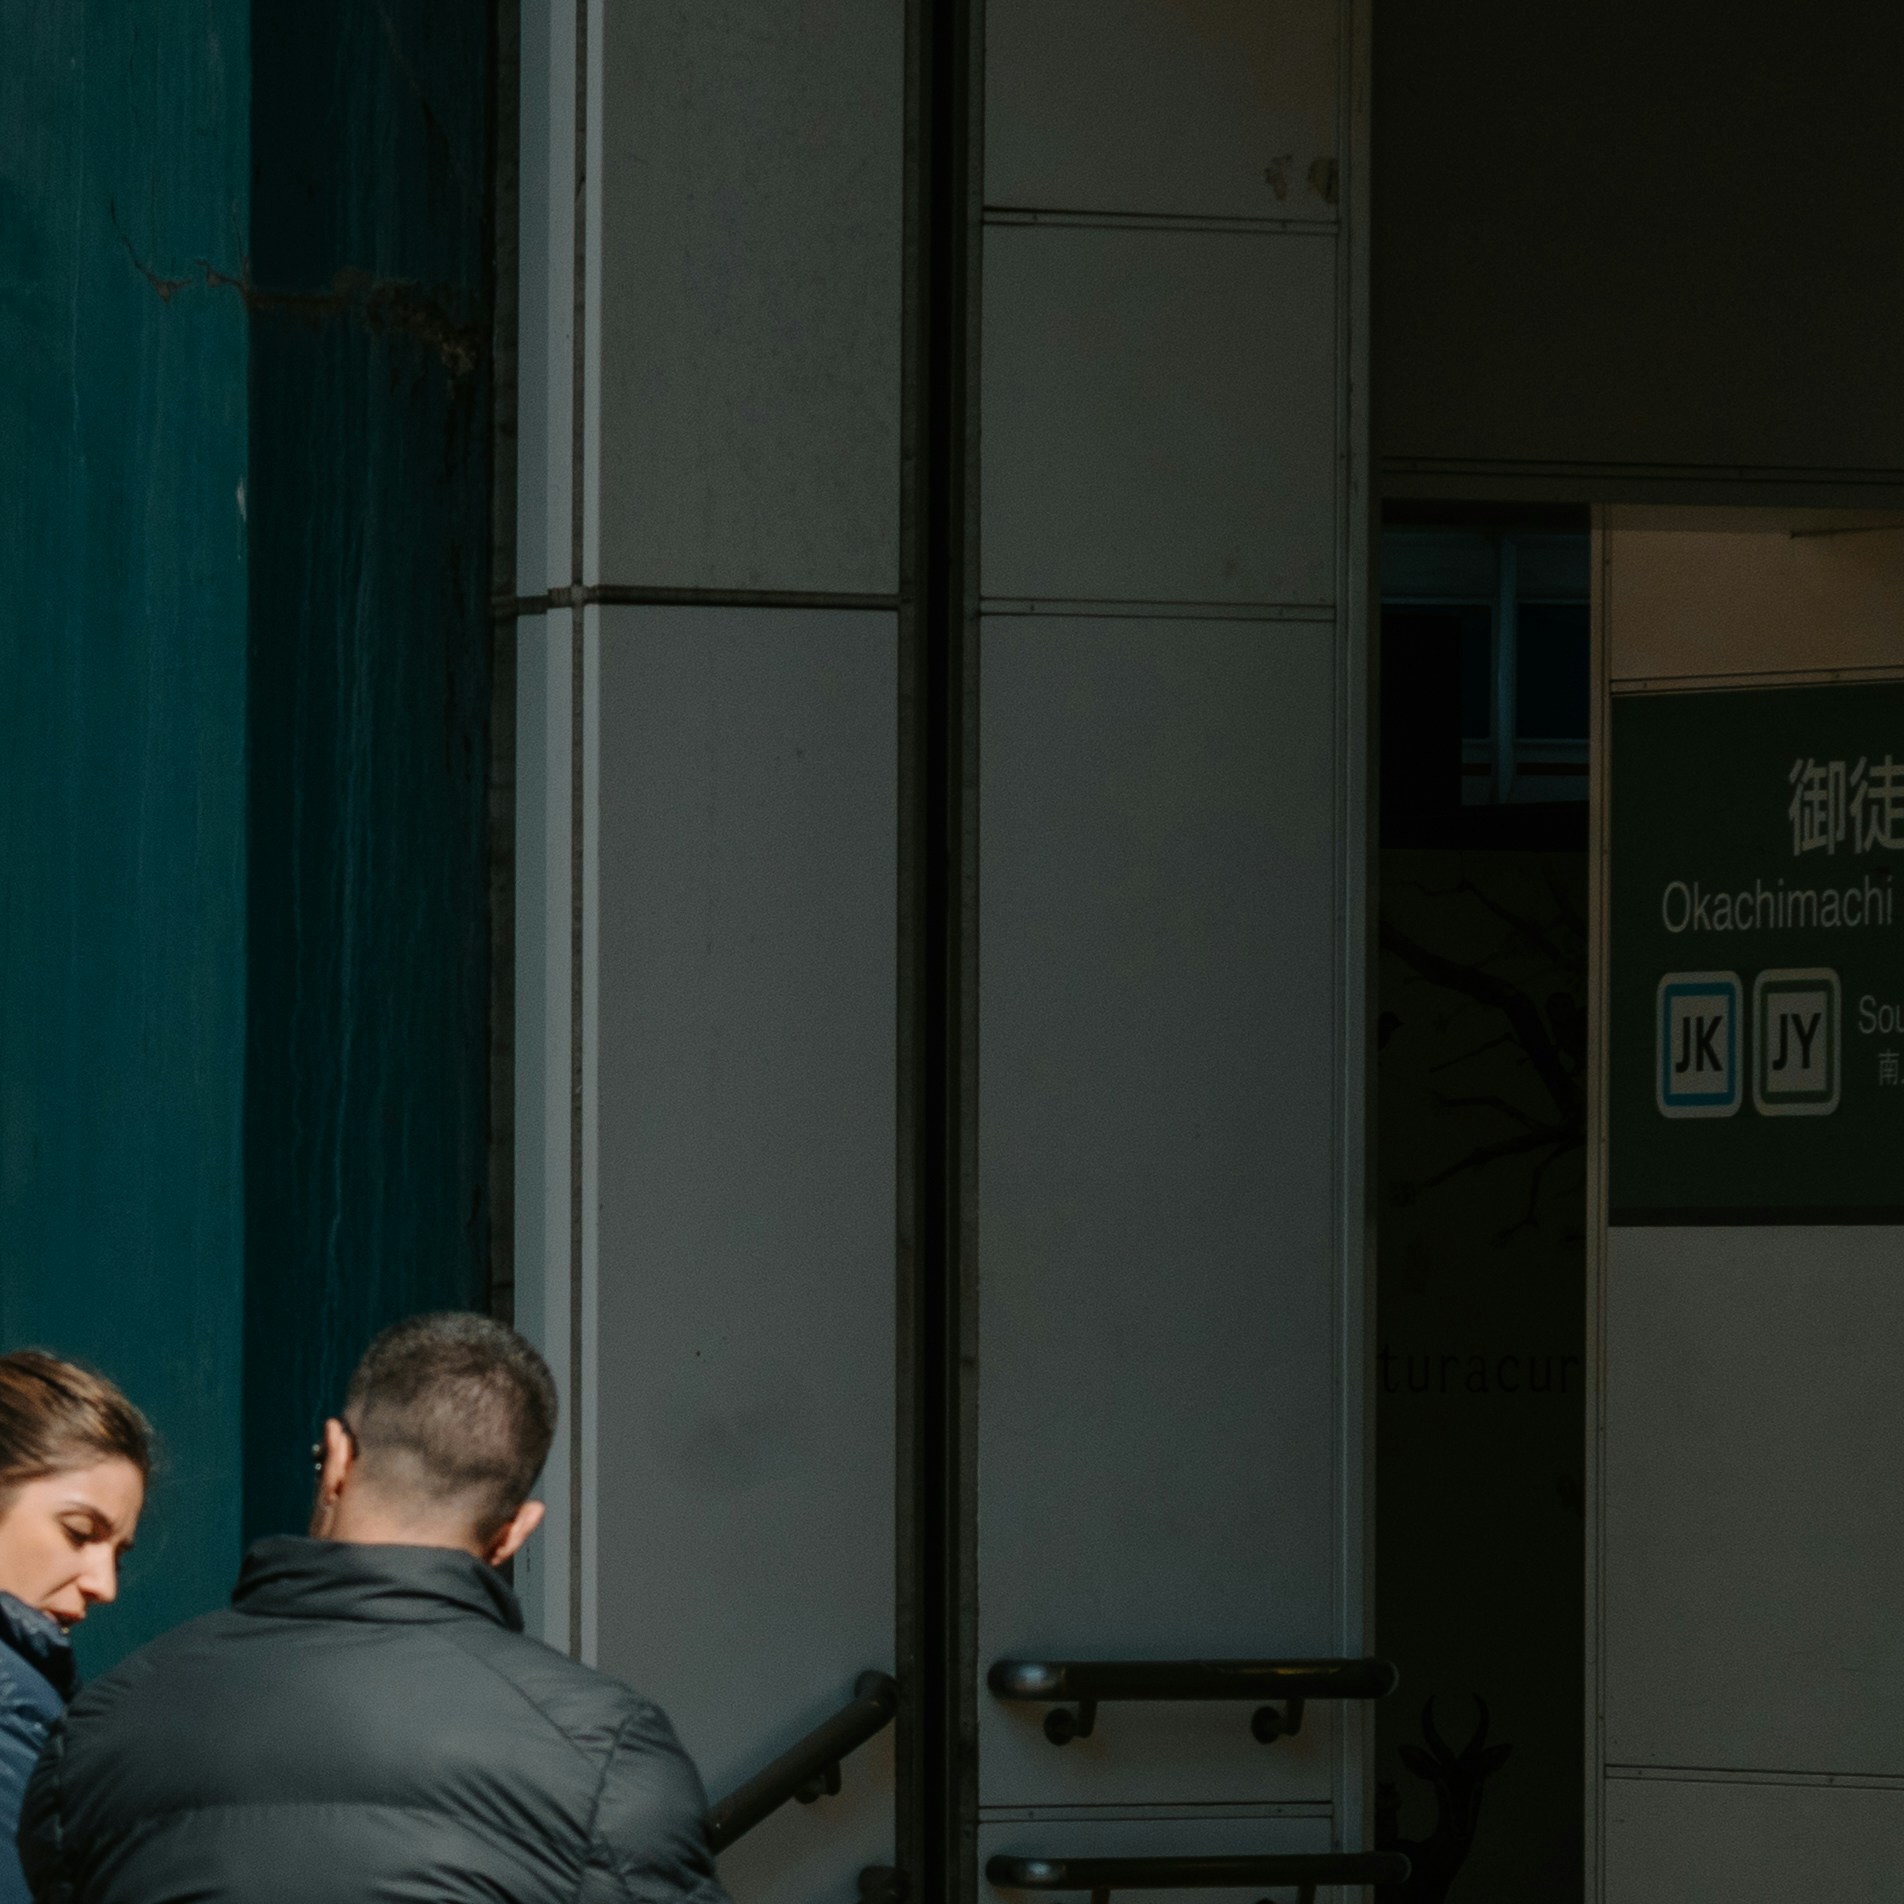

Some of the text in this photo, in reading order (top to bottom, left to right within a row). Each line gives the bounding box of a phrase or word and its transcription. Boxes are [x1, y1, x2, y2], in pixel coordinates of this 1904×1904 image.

[1787, 754, 1904, 857] 御徒
[1661, 876, 1893, 934] Okachimachi
[1674, 1013, 1822, 1074] JK JY
